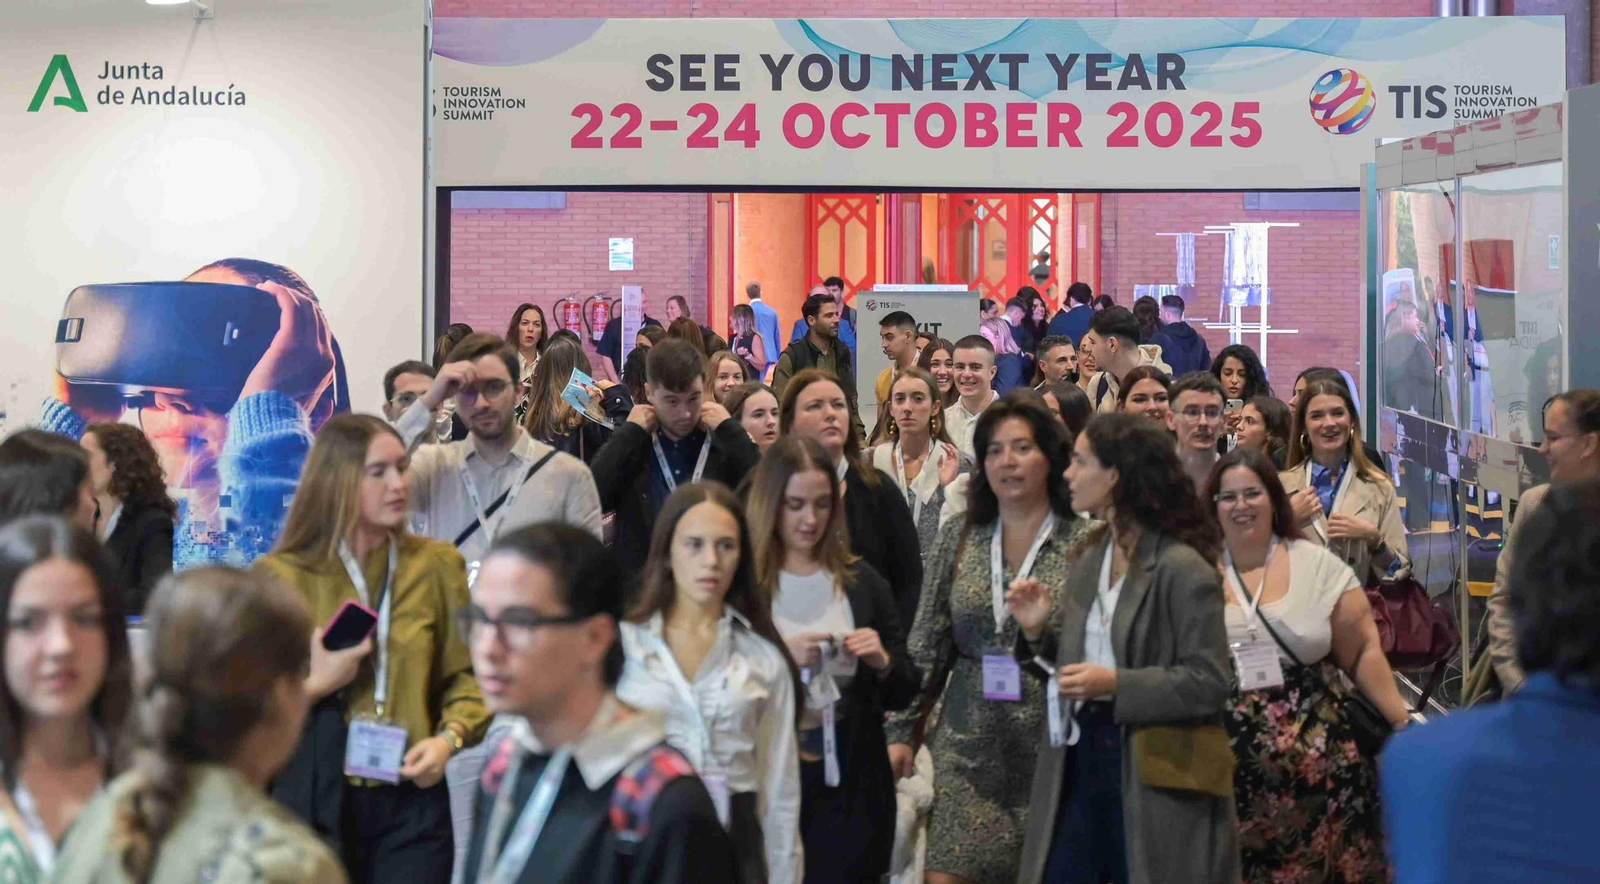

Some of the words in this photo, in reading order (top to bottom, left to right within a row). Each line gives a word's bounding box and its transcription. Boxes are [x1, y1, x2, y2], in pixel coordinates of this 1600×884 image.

[97, 61, 164, 80] Junta
[646, 53, 741, 92] SEE
[760, 53, 872, 92] YOU
[891, 53, 1029, 92] NEXT
[1045, 53, 1187, 91] YEAR
[97, 85, 125, 105] de
[130, 83, 246, 106] Andalucía
[443, 86, 502, 97] TOURISM
[1454, 85, 1513, 96] TOURISM
[443, 98, 526, 109] INNOVATION
[1388, 84, 1448, 119] TIS
[1454, 97, 1537, 107] INNOVATION
[443, 110, 495, 120] SUMMIT
[1454, 108, 1506, 119] SUMMIT
[782, 102, 1083, 149] OCTOBER
[1106, 101, 1263, 149] 2025
[879, 301, 890, 309] TIS
